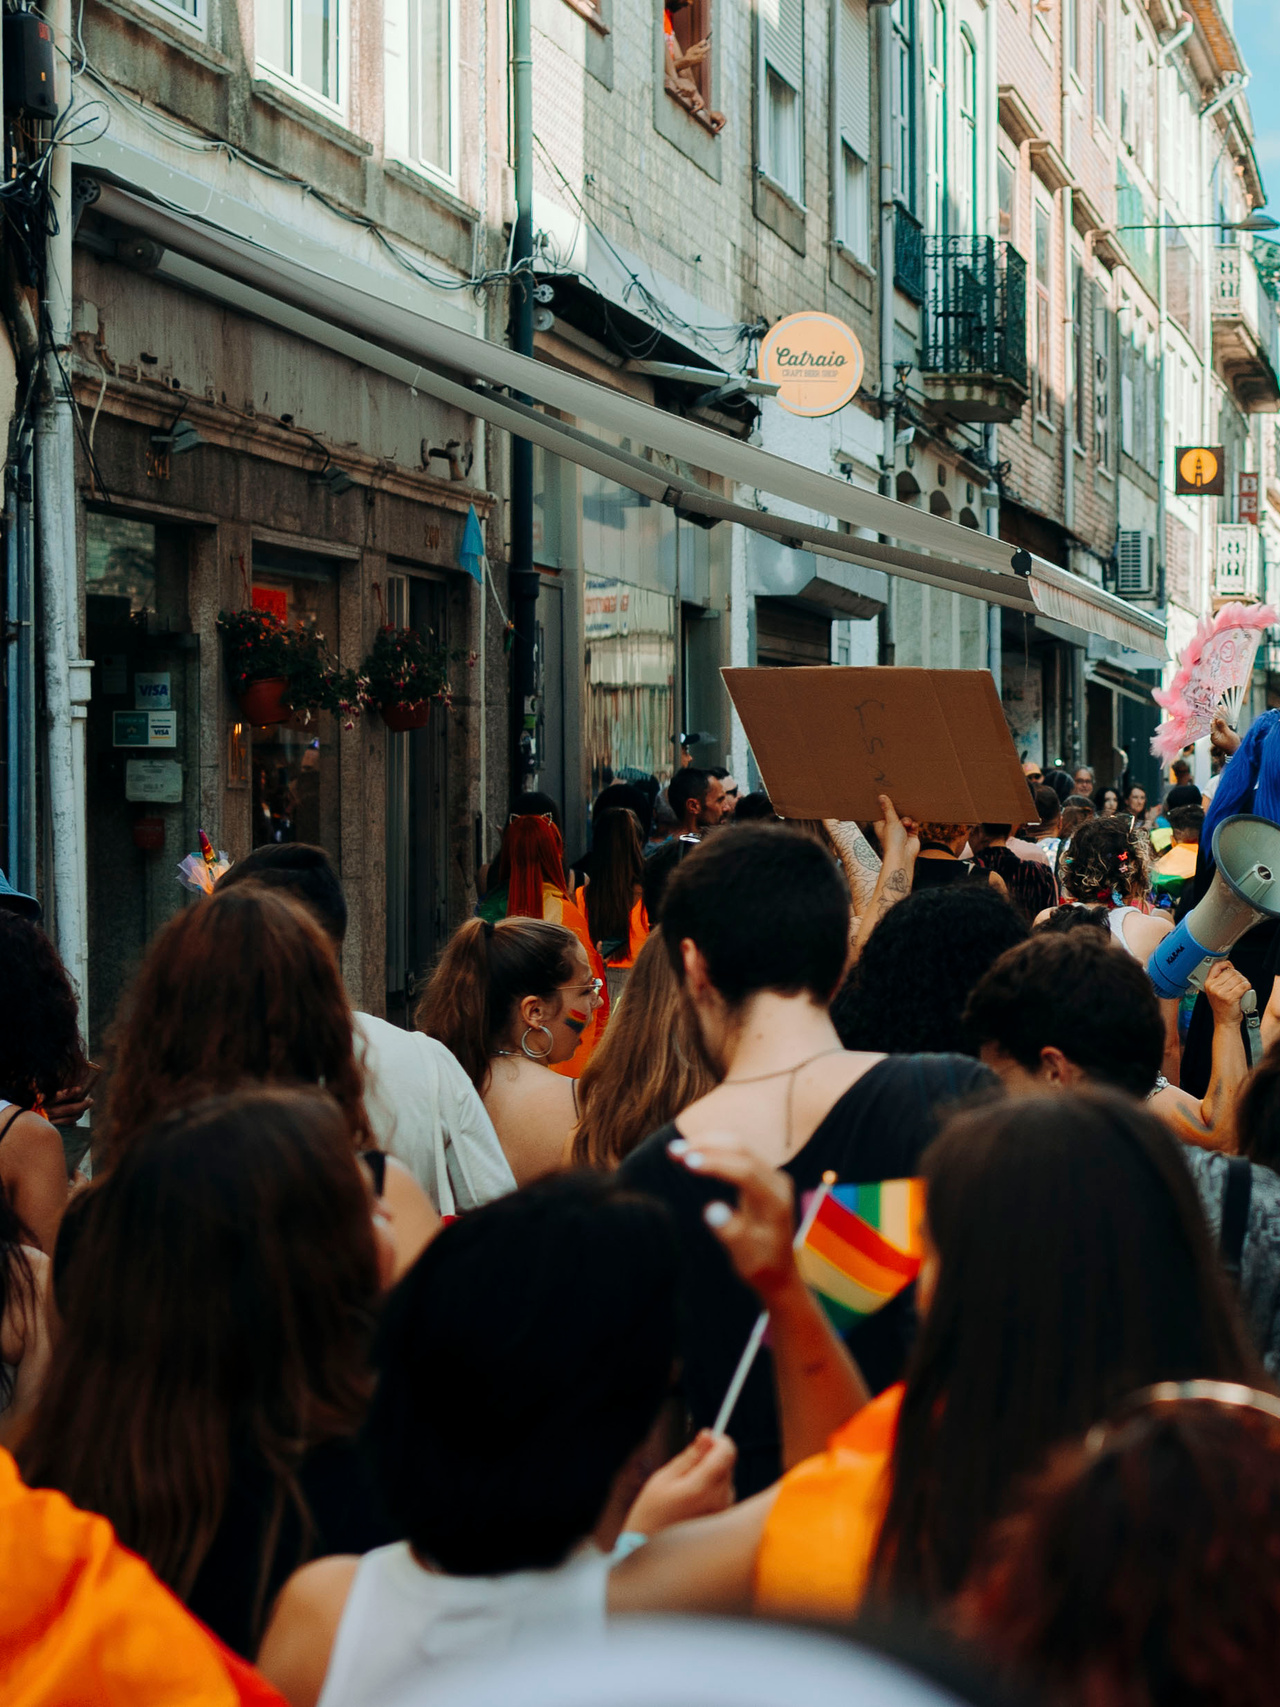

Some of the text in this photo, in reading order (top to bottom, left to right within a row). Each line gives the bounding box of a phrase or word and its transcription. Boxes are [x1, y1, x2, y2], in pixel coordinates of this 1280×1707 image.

[776, 346, 848, 367] Catraio
[782, 369, 803, 377] CRAFT
[140, 685, 168, 696] VISA
